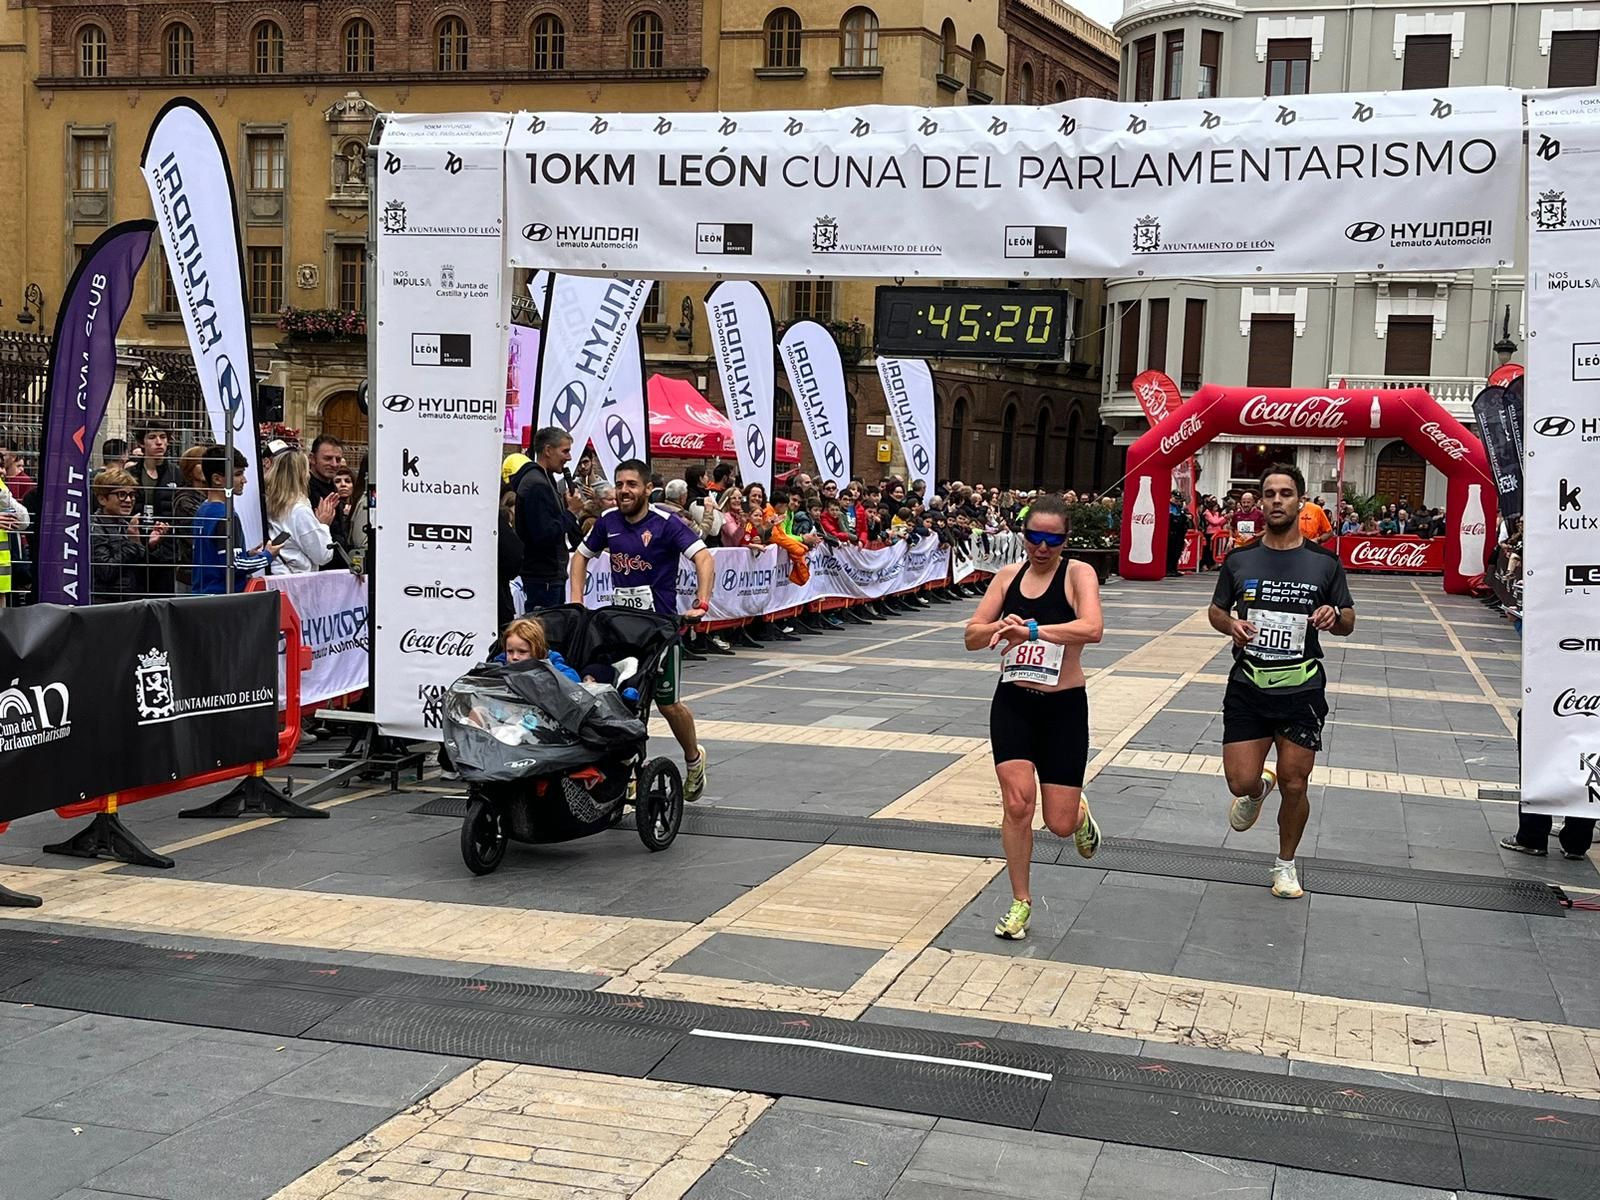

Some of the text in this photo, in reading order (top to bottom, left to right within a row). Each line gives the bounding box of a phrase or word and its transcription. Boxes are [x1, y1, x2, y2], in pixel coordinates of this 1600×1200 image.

[526, 138, 1497, 190] 10KM LEÓN CUNA DEL PARLAMENTARISMO
[408, 226, 466, 234] AYUNTAMIENTO
[480, 225, 500, 234] LEÓN
[556, 226, 639, 242] HYUNDAI
[1390, 220, 1492, 239] HYUNDAI
[556, 241, 638, 250] Lemauto Automoción
[699, 232, 722, 244] LEÓN
[1008, 236, 1033, 246] LEÓN
[1162, 239, 1275, 251] AYUNTAMIENTO DE LEÓN
[1390, 236, 1492, 248] Lemauto Automoción
[839, 244, 905, 252] AYUNTAMIENTO
[920, 244, 942, 253] LEÓN
[393, 278, 432, 288] IMPULSA
[456, 282, 488, 290] Junta de
[436, 289, 462, 297] Castilla
[469, 289, 489, 298] León
[415, 343, 438, 354] LEÓN
[597, 323, 627, 381] Lemauto
[1577, 354, 1600, 366] LEÓ
[419, 398, 497, 413] HYUNDAI
[1239, 394, 1352, 428] Coca-Cola
[418, 412, 497, 421] Lemauto Automoción
[660, 432, 708, 449] Coca-Cola
[1160, 413, 1204, 454] Coca-Cola
[1420, 422, 1471, 460] Coca-Cola
[402, 479, 480, 495] kutxabank
[1558, 514, 1598, 530] kutx
[63, 466, 84, 601] ALTAFIT
[410, 525, 471, 541] LEON
[408, 542, 472, 552] PLAZA
[1351, 540, 1431, 568] Coca-Cola
[404, 580, 475, 600] emico
[1262, 580, 1318, 592] FUTURE
[1262, 587, 1310, 597] SPORT
[398, 628, 479, 657] Coca-Cola
[1258, 628, 1292, 649] 506
[1016, 645, 1045, 665] 813
[239, 692, 251, 704] DE
[252, 686, 274, 702] LEÓN
[21, 717, 37, 734] del
[0, 726, 71, 752] Parlamentarismo
